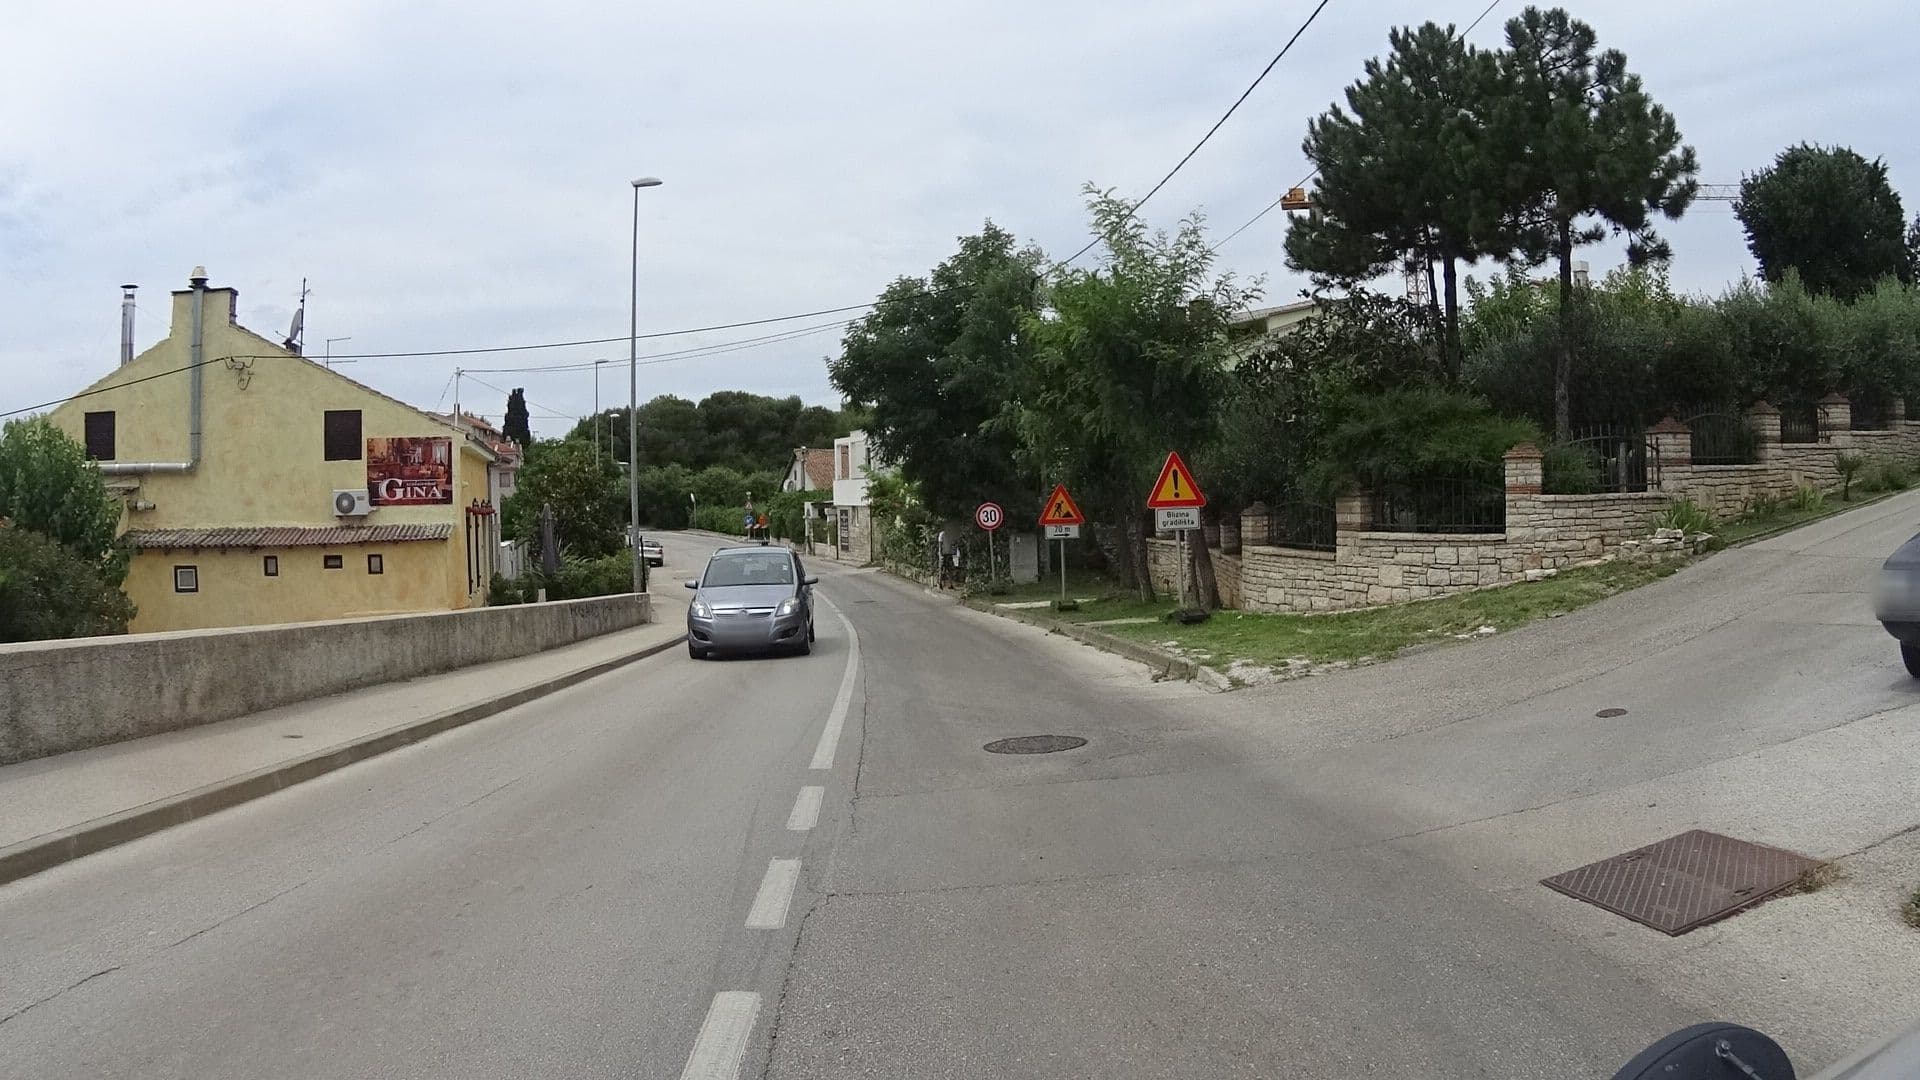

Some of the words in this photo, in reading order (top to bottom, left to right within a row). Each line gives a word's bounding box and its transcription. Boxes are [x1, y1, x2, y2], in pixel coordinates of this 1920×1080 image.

[379, 478, 442, 500] GINA
[982, 510, 996, 522] 30
[1054, 525, 1063, 533] 70
